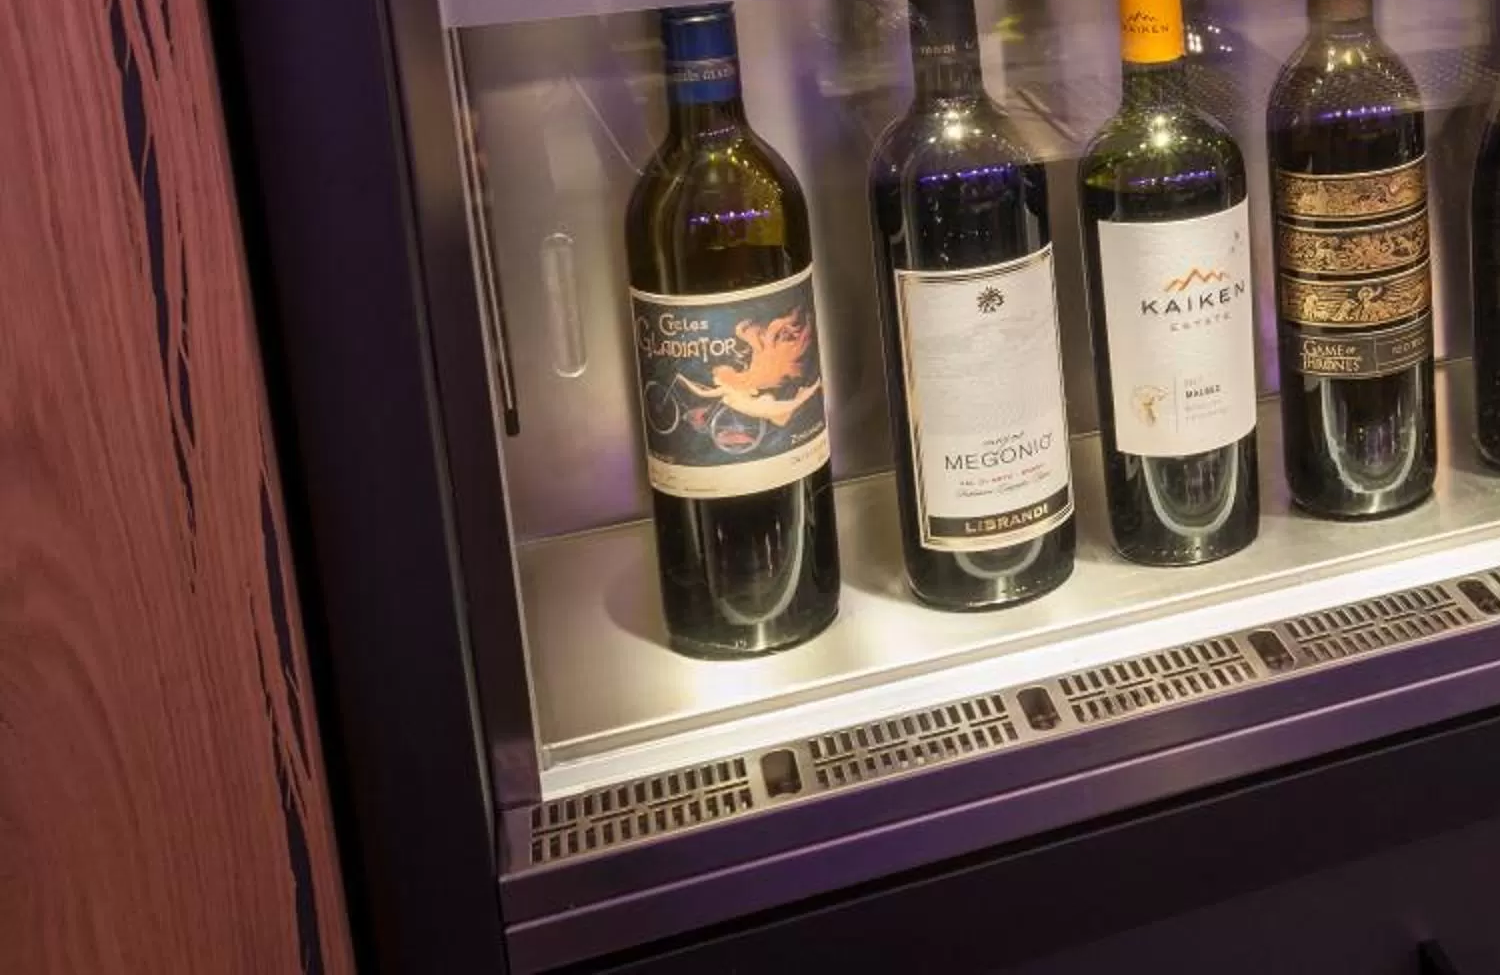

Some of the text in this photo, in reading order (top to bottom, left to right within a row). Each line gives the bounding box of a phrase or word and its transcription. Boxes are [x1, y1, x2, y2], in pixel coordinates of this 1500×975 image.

[1140, 280, 1245, 315] KAIKEN
[659, 313, 708, 336] Cycles
[1303, 340, 1345, 356] GAME
[1302, 353, 1360, 372] THRONES
[944, 433, 1053, 470] MEGONIO
[964, 503, 1049, 534] LIBRANDI
